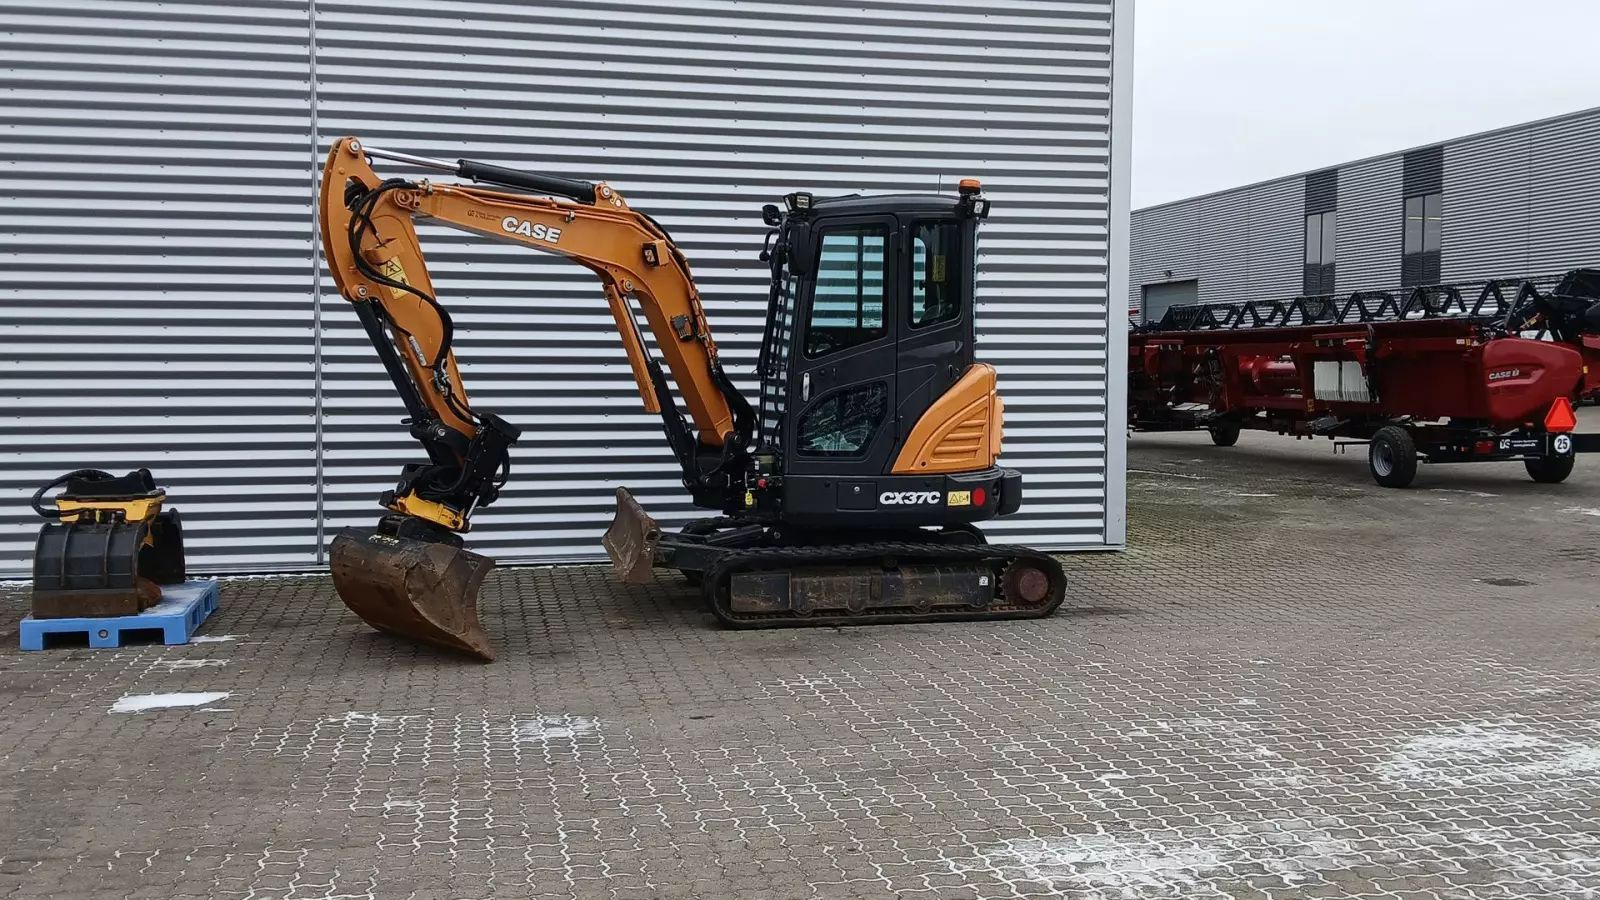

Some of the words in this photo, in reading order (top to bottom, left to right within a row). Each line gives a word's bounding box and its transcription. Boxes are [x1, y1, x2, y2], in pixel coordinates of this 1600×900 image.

[501, 216, 561, 243] CASE
[1488, 370, 1511, 380] CASE
[1557, 438, 1568, 450] 25
[880, 491, 941, 505] CX37C
